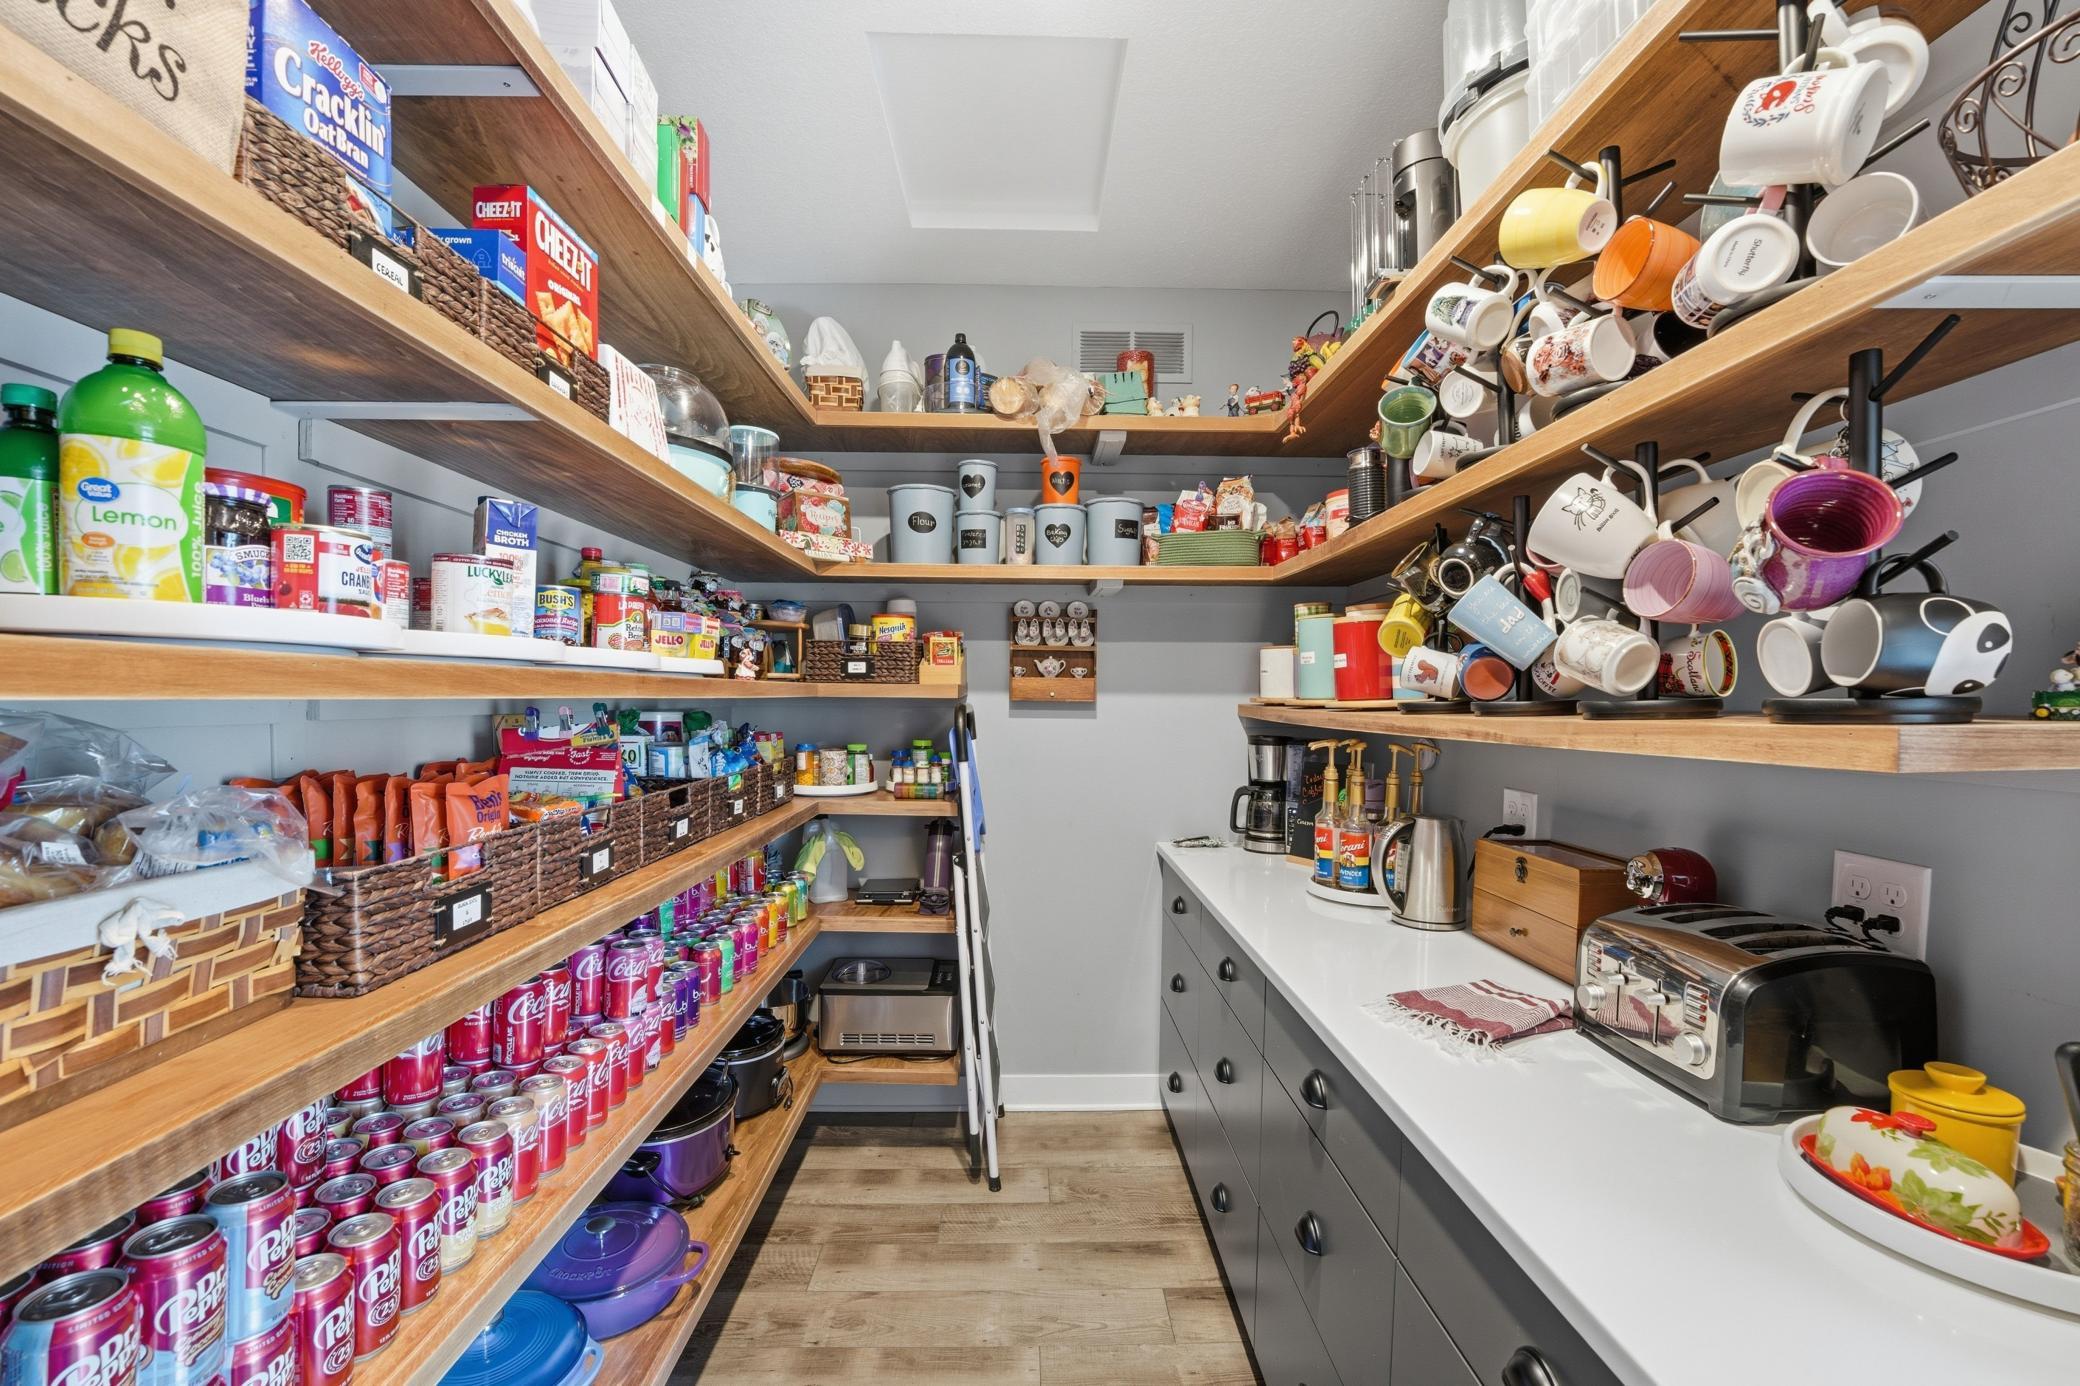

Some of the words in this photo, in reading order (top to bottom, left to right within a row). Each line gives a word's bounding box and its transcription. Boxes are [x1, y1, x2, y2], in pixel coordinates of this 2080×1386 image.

[53, 0, 187, 101] cks
[310, 42, 364, 100] Kellogg's
[274, 47, 385, 157] Cracklin'
[303, 107, 338, 144] Oat
[337, 129, 369, 168] Bran
[475, 201, 523, 218] CHEEZ-IT
[445, 237, 472, 246] grown
[535, 211, 592, 292] CHEEZ-IT
[376, 263, 403, 286] CEREAL
[80, 482, 113, 493] Great
[88, 491, 113, 499] Value
[192, 482, 205, 529] Juice
[92, 505, 177, 531] Lemon
[912, 515, 936, 527] Flour
[494, 535, 529, 547] BROTH
[192, 536, 203, 578] 100%
[468, 565, 502, 579] LUCKY
[539, 594, 574, 607] BUSH'S
[879, 623, 906, 634] Nesquik
[1500, 606, 1525, 634] dad
[172, 1249, 207, 1268] LIMITED
[197, 1264, 225, 1301] Dr
[68, 1310, 110, 1334] LIMITED
[100, 1324, 135, 1363] Dr
